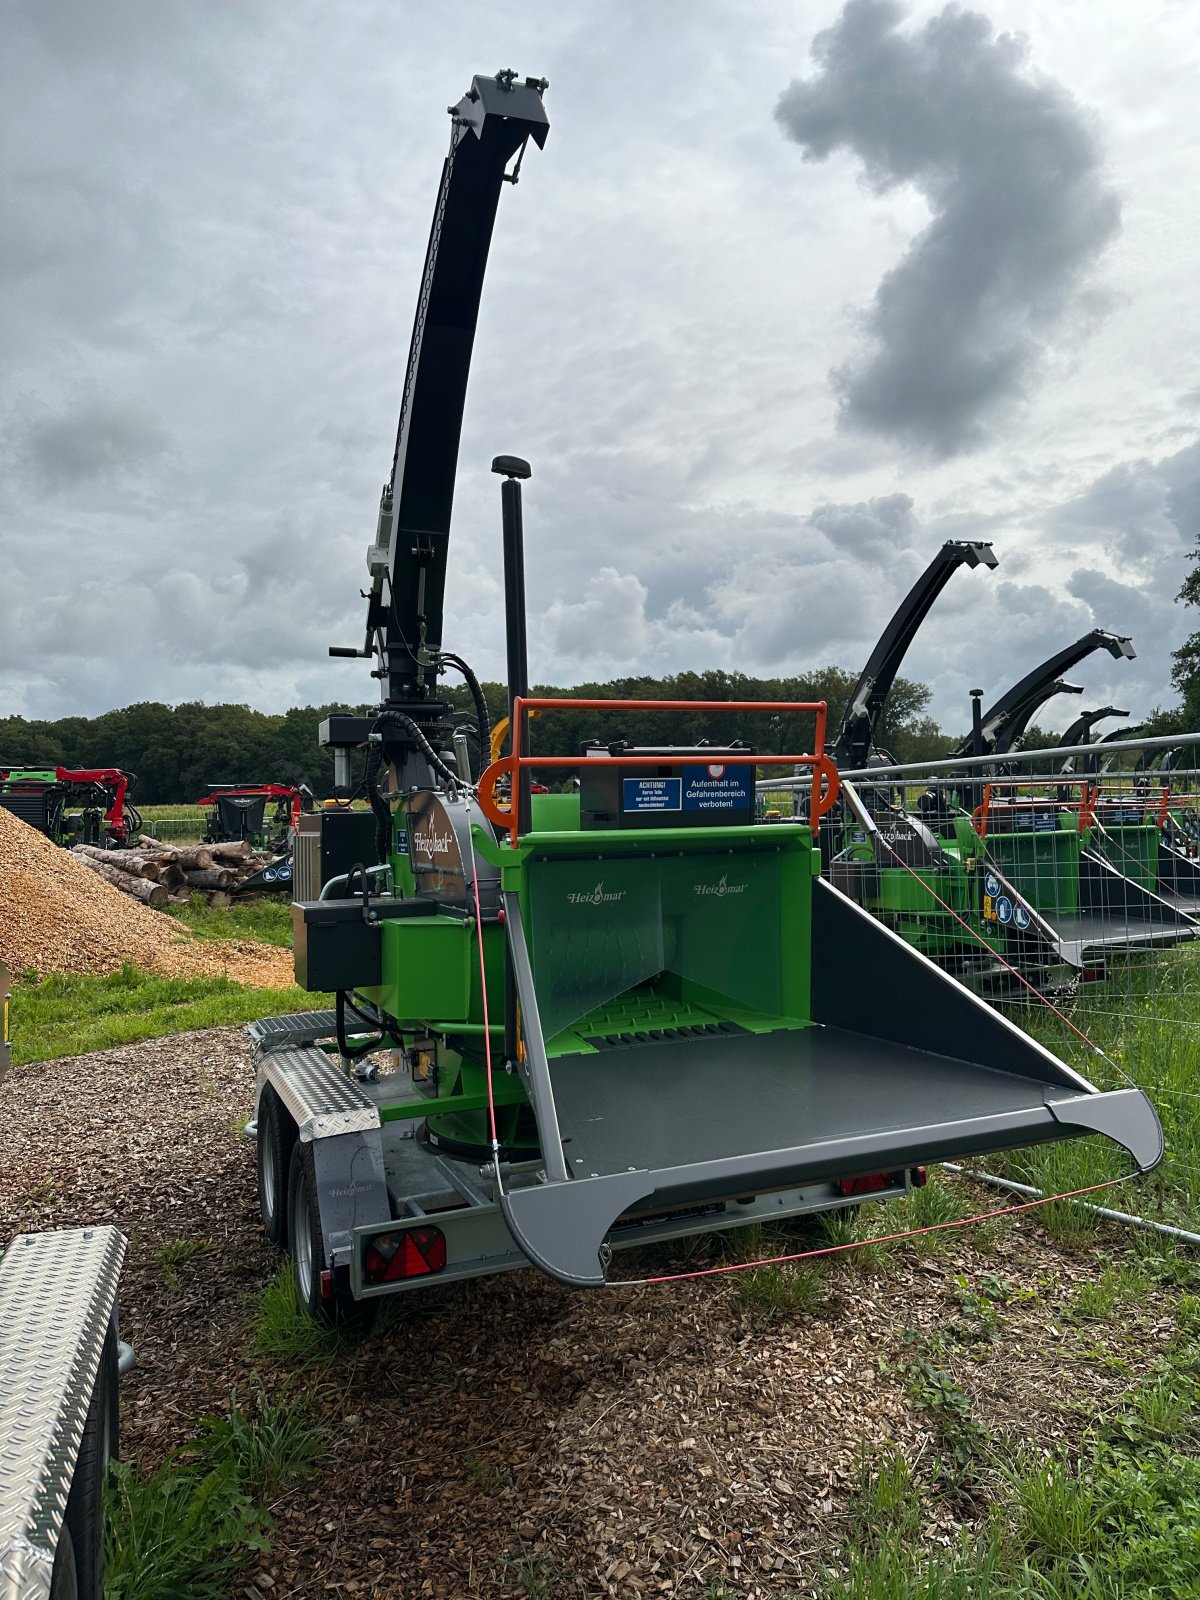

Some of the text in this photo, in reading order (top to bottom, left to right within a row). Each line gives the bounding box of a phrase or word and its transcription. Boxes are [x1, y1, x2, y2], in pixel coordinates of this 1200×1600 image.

[639, 781, 666, 789] ACHTUNG!
[690, 780, 729, 788] Aufenthalt
[686, 790, 746, 798] Gefahrenbereich
[693, 879, 749, 897] Heizomat
[567, 887, 627, 905] Heizomat
